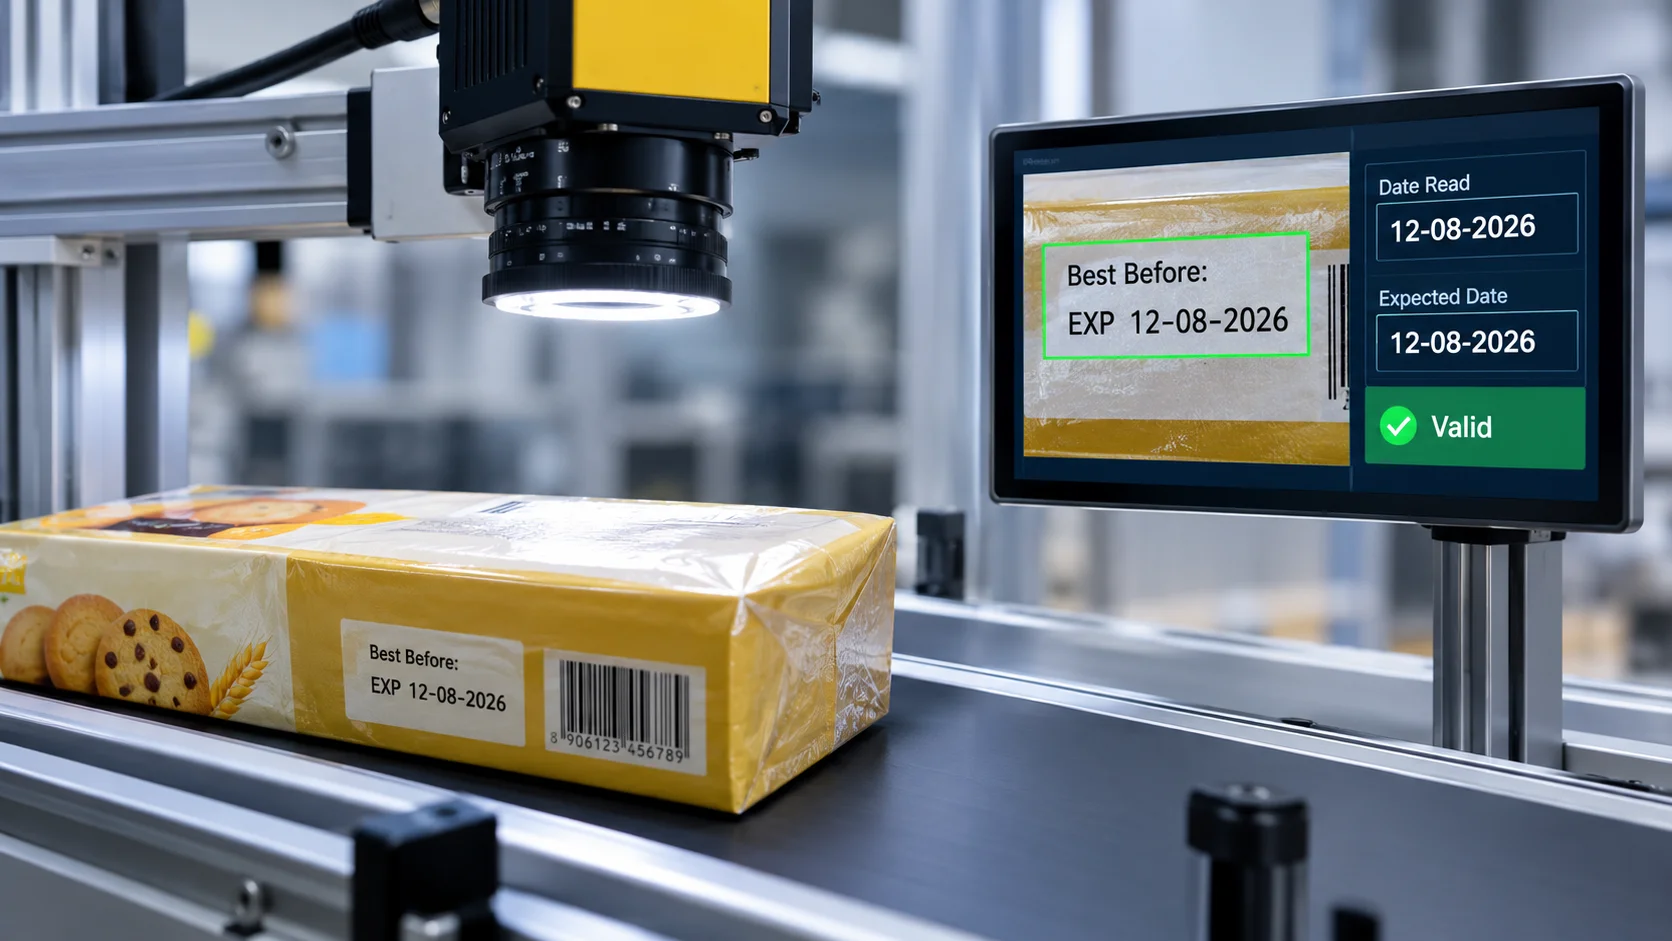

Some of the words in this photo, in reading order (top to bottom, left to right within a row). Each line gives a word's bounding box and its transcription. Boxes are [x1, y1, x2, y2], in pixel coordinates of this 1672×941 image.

[1379, 178, 1420, 196] Date
[1425, 174, 1470, 194] Read
[1390, 213, 1536, 243] 12-08-2026
[1067, 264, 1117, 287] Best
[1124, 261, 1207, 285] Before:
[1379, 288, 1461, 311] Expected
[1466, 288, 1508, 305] Date
[1068, 310, 1115, 336] EXP
[1130, 306, 1289, 335] 12-08-2026
[1390, 329, 1536, 354] 12-08-2026
[1431, 415, 1492, 439] Valid
[369, 643, 402, 664] Best
[405, 648, 459, 671] Before:
[371, 676, 402, 696] EXP
[408, 682, 507, 713] 12-08-2026
[550, 731, 559, 744] 8
[566, 733, 621, 753] 906123
[627, 743, 684, 764] 456789
